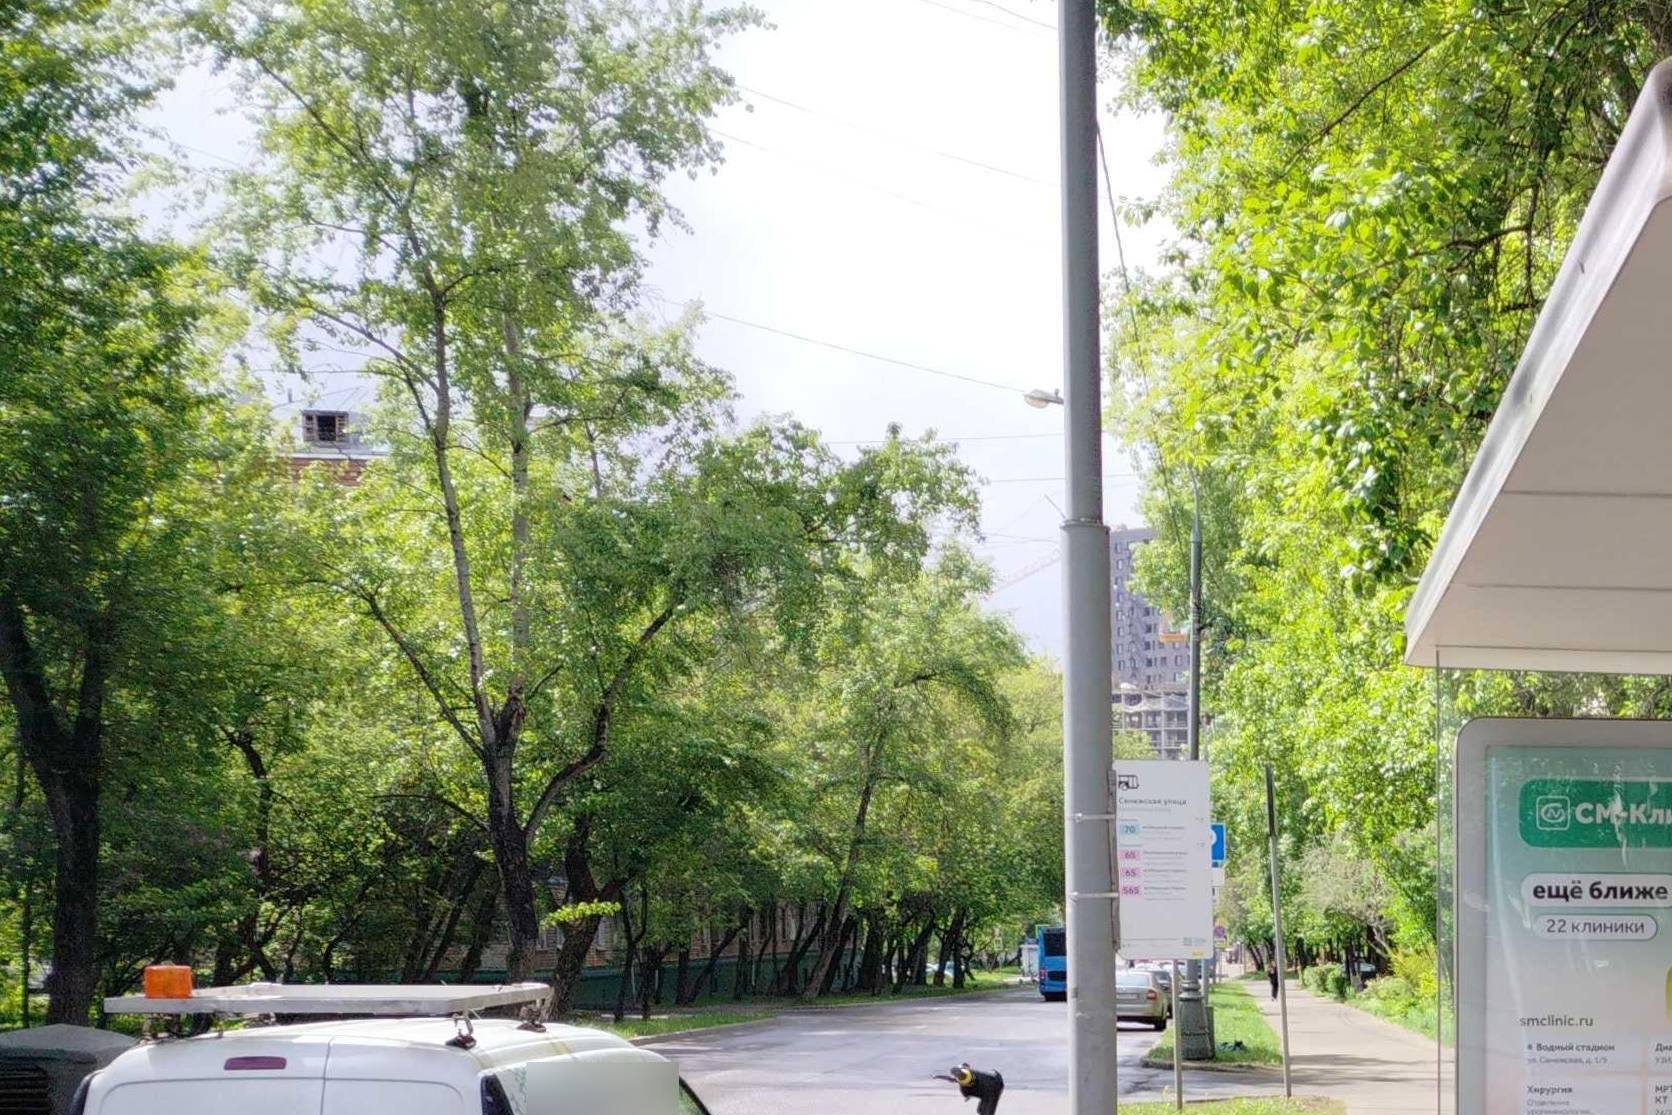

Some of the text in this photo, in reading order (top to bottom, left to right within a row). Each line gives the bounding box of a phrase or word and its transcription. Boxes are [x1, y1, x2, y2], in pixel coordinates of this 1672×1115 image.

[1533, 879, 1669, 902] ещё ближе
[1546, 918, 1645, 935] 22 клиники
[1519, 1015, 1594, 1027] smclinic.ru
[1536, 1042, 1615, 1053] Водный стадион
[1527, 1085, 1573, 1097] Хирургия
[1655, 1096, 1668, 1105] КТ
